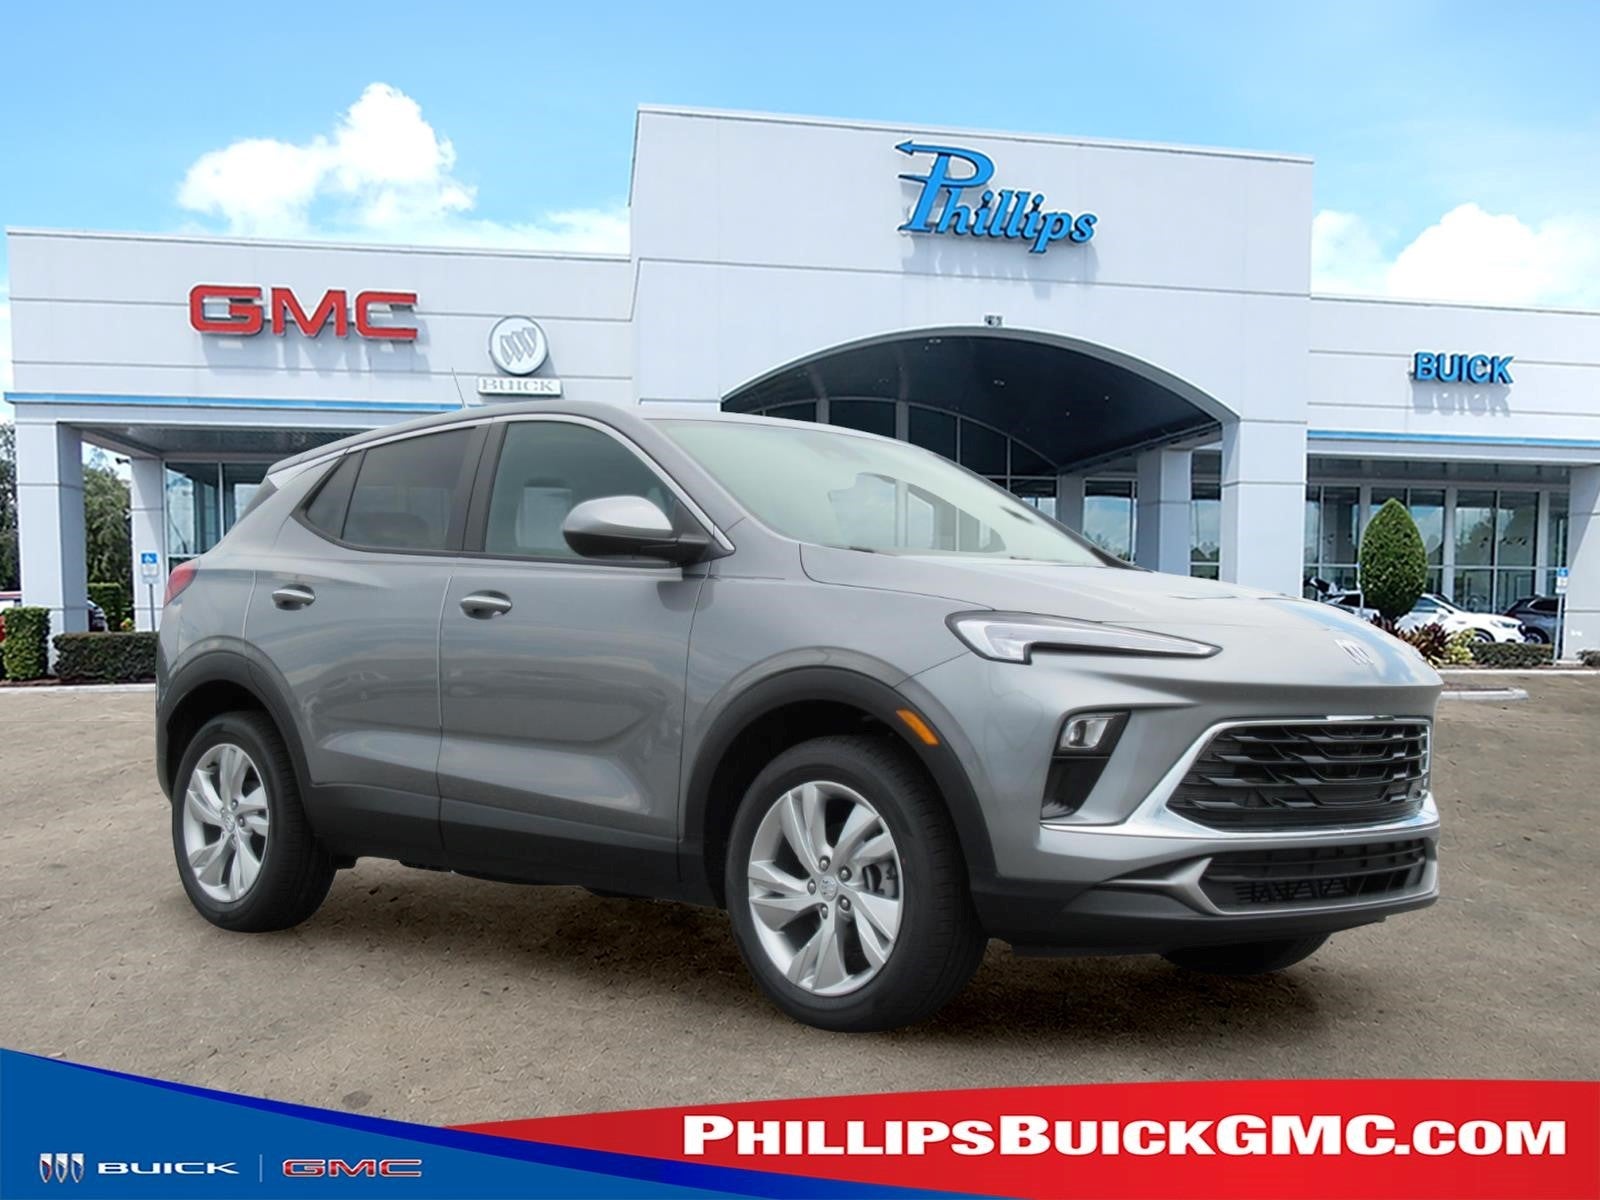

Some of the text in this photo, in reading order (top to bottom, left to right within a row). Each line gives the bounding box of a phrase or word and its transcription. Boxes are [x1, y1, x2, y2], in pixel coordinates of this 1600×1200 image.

[895, 140, 1098, 254] Phillips
[189, 284, 418, 341] GMC
[482, 378, 555, 392] BUICK
[1414, 352, 1514, 384] BUICK
